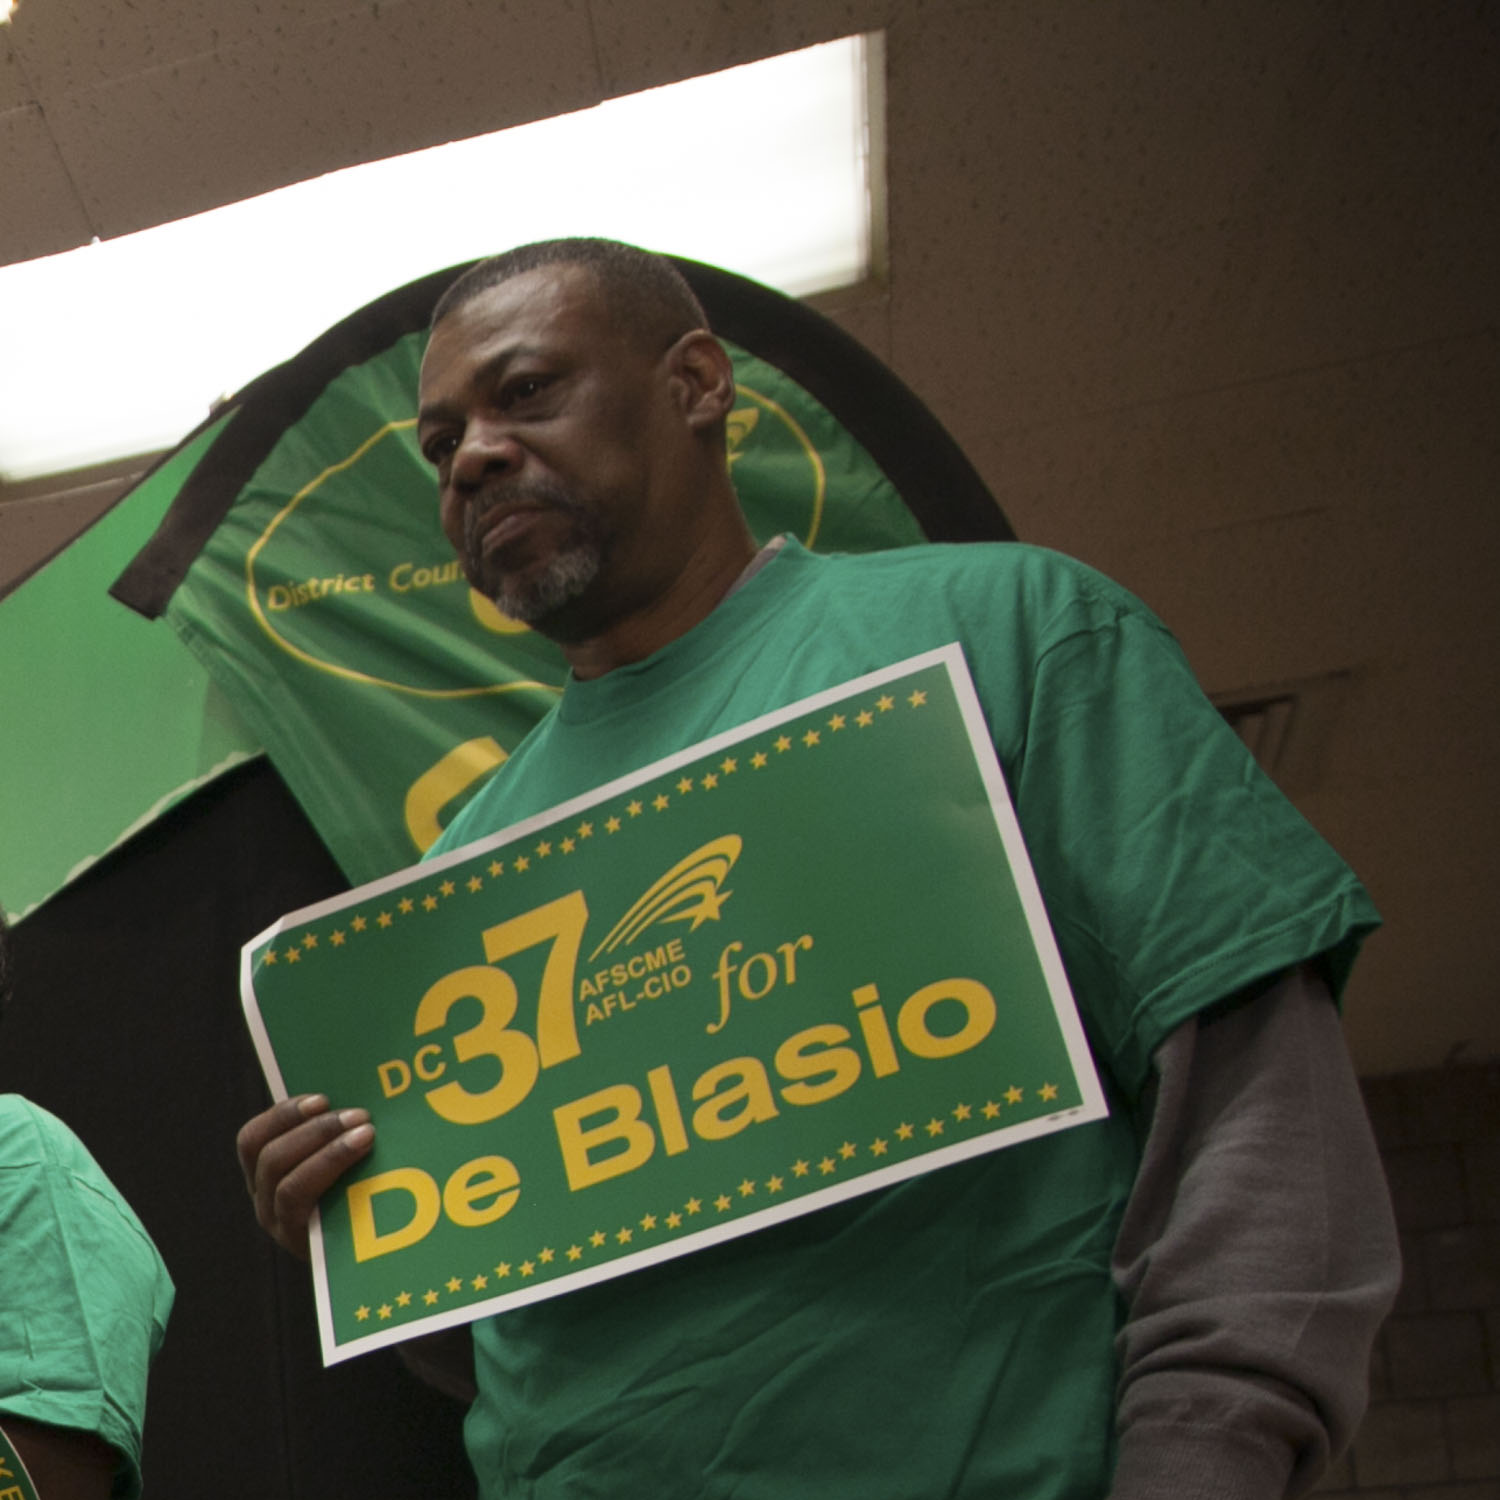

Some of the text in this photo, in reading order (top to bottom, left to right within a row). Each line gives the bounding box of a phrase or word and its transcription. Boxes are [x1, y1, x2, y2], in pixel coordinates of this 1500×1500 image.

[267, 572, 375, 611] District
[377, 889, 590, 1125] DC 37
[577, 939, 686, 1002] AFSCME
[584, 965, 693, 1026] AFL-CIO
[706, 935, 814, 1033] for
[346, 977, 997, 1263] De Blasio
